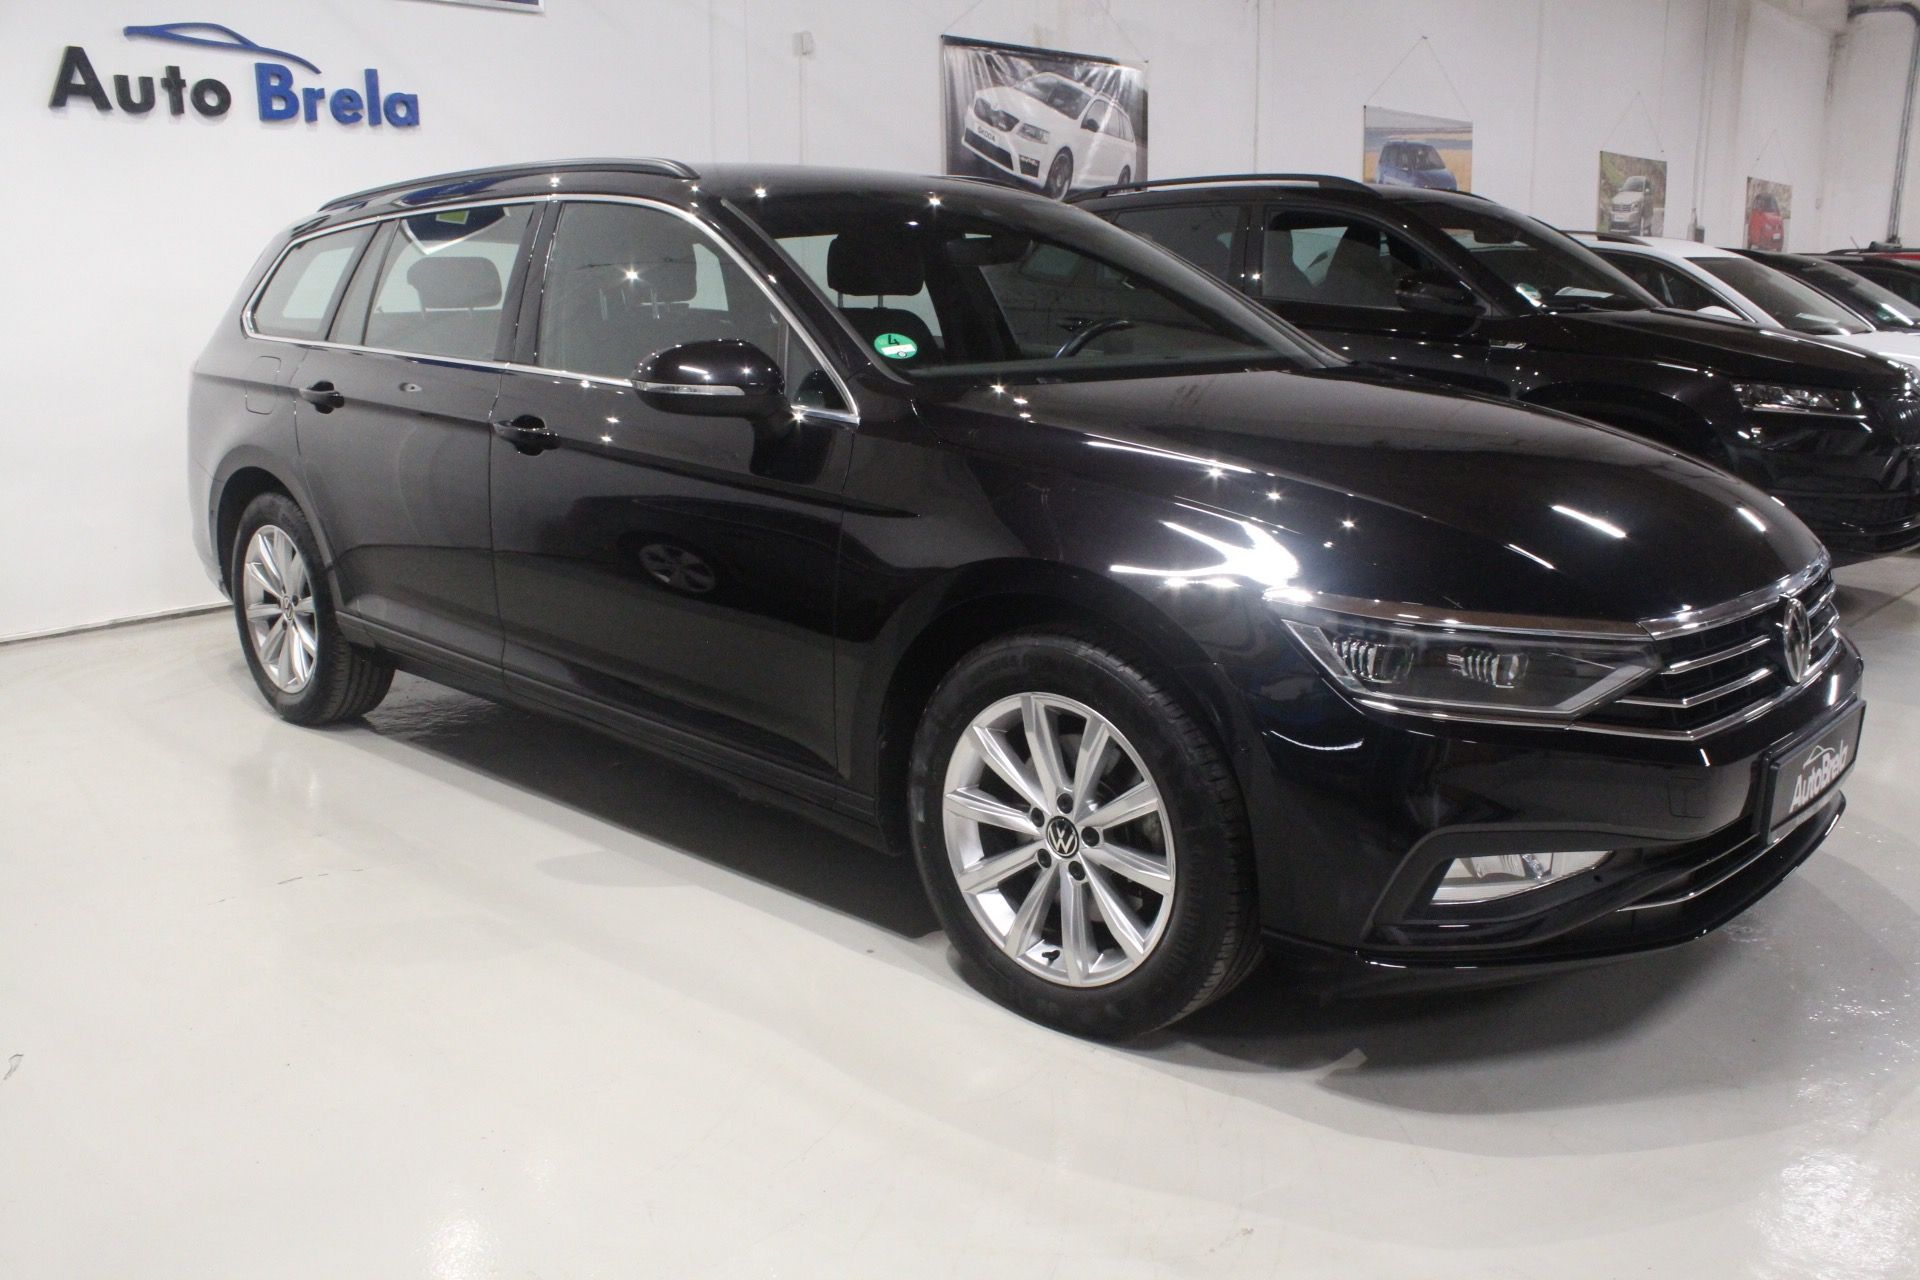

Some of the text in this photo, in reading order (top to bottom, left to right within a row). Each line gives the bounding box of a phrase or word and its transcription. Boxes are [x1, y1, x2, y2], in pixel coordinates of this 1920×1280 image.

[48, 45, 420, 128] Auto Brela
[888, 334, 900, 346] 4
